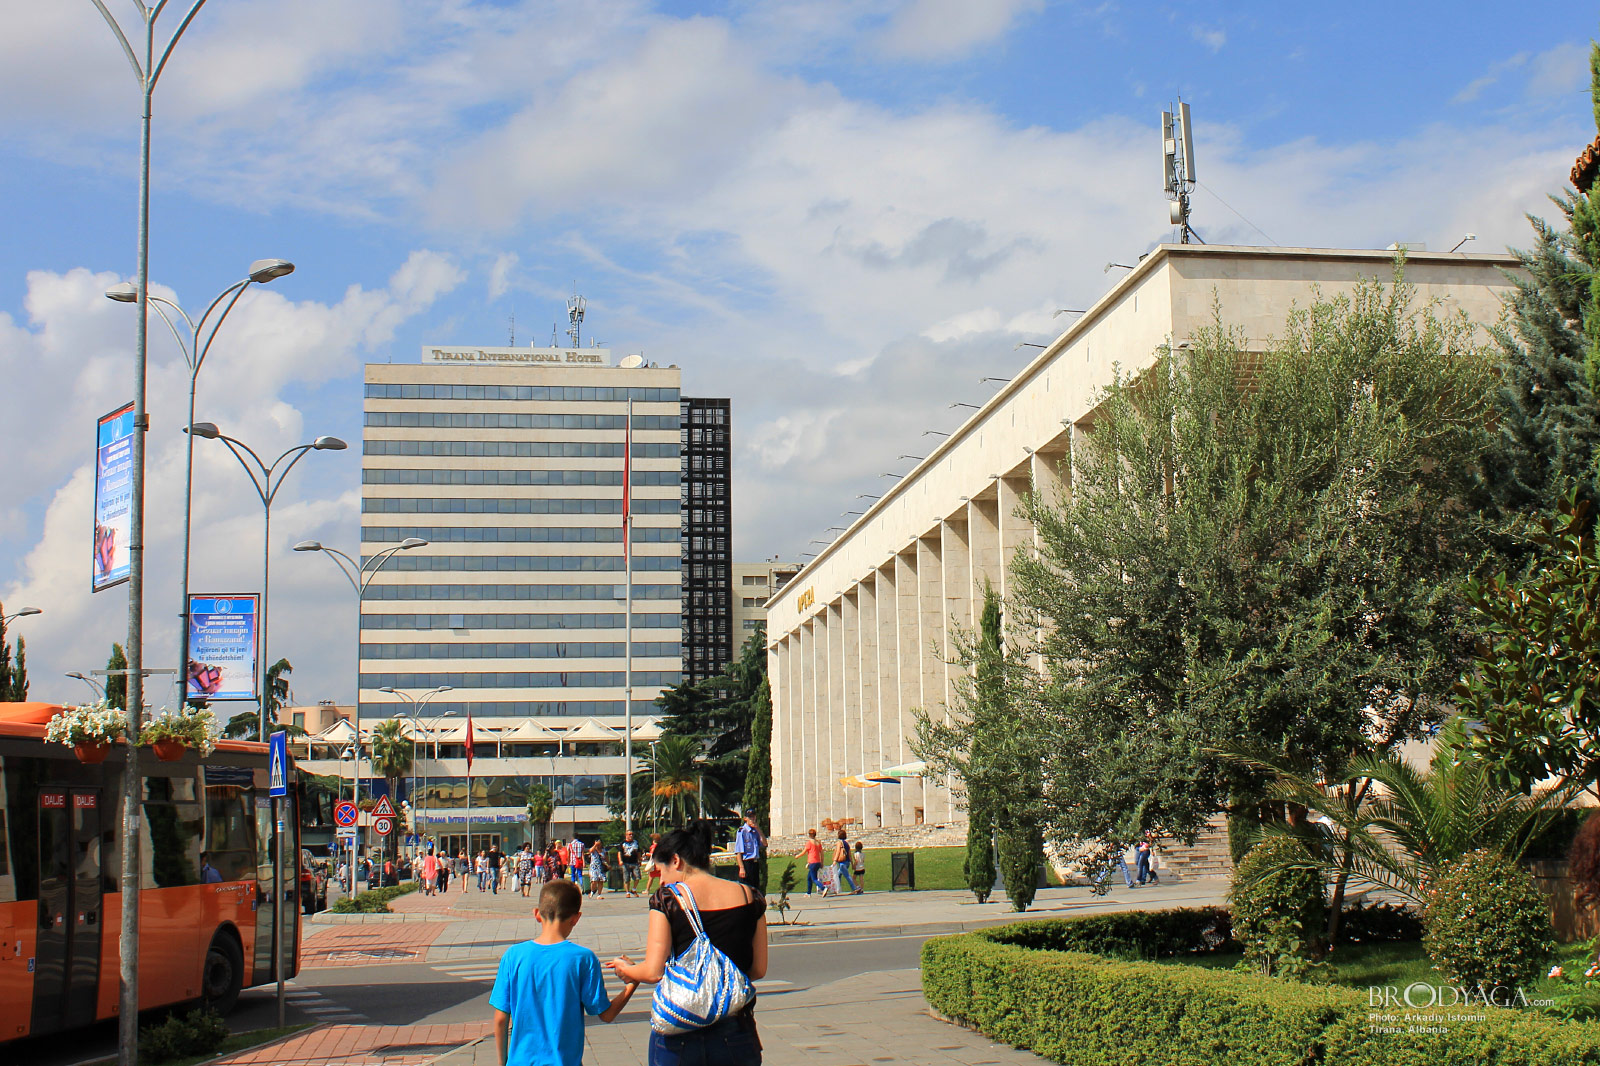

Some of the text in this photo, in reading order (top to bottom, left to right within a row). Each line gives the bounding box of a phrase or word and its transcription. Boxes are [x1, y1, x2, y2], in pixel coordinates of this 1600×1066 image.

[432, 349, 602, 363] TIRANA INTERNATIONAL HOTEL
[44, 795, 64, 806] DALJE
[76, 796, 95, 806] DALJE
[378, 822, 389, 831] 30
